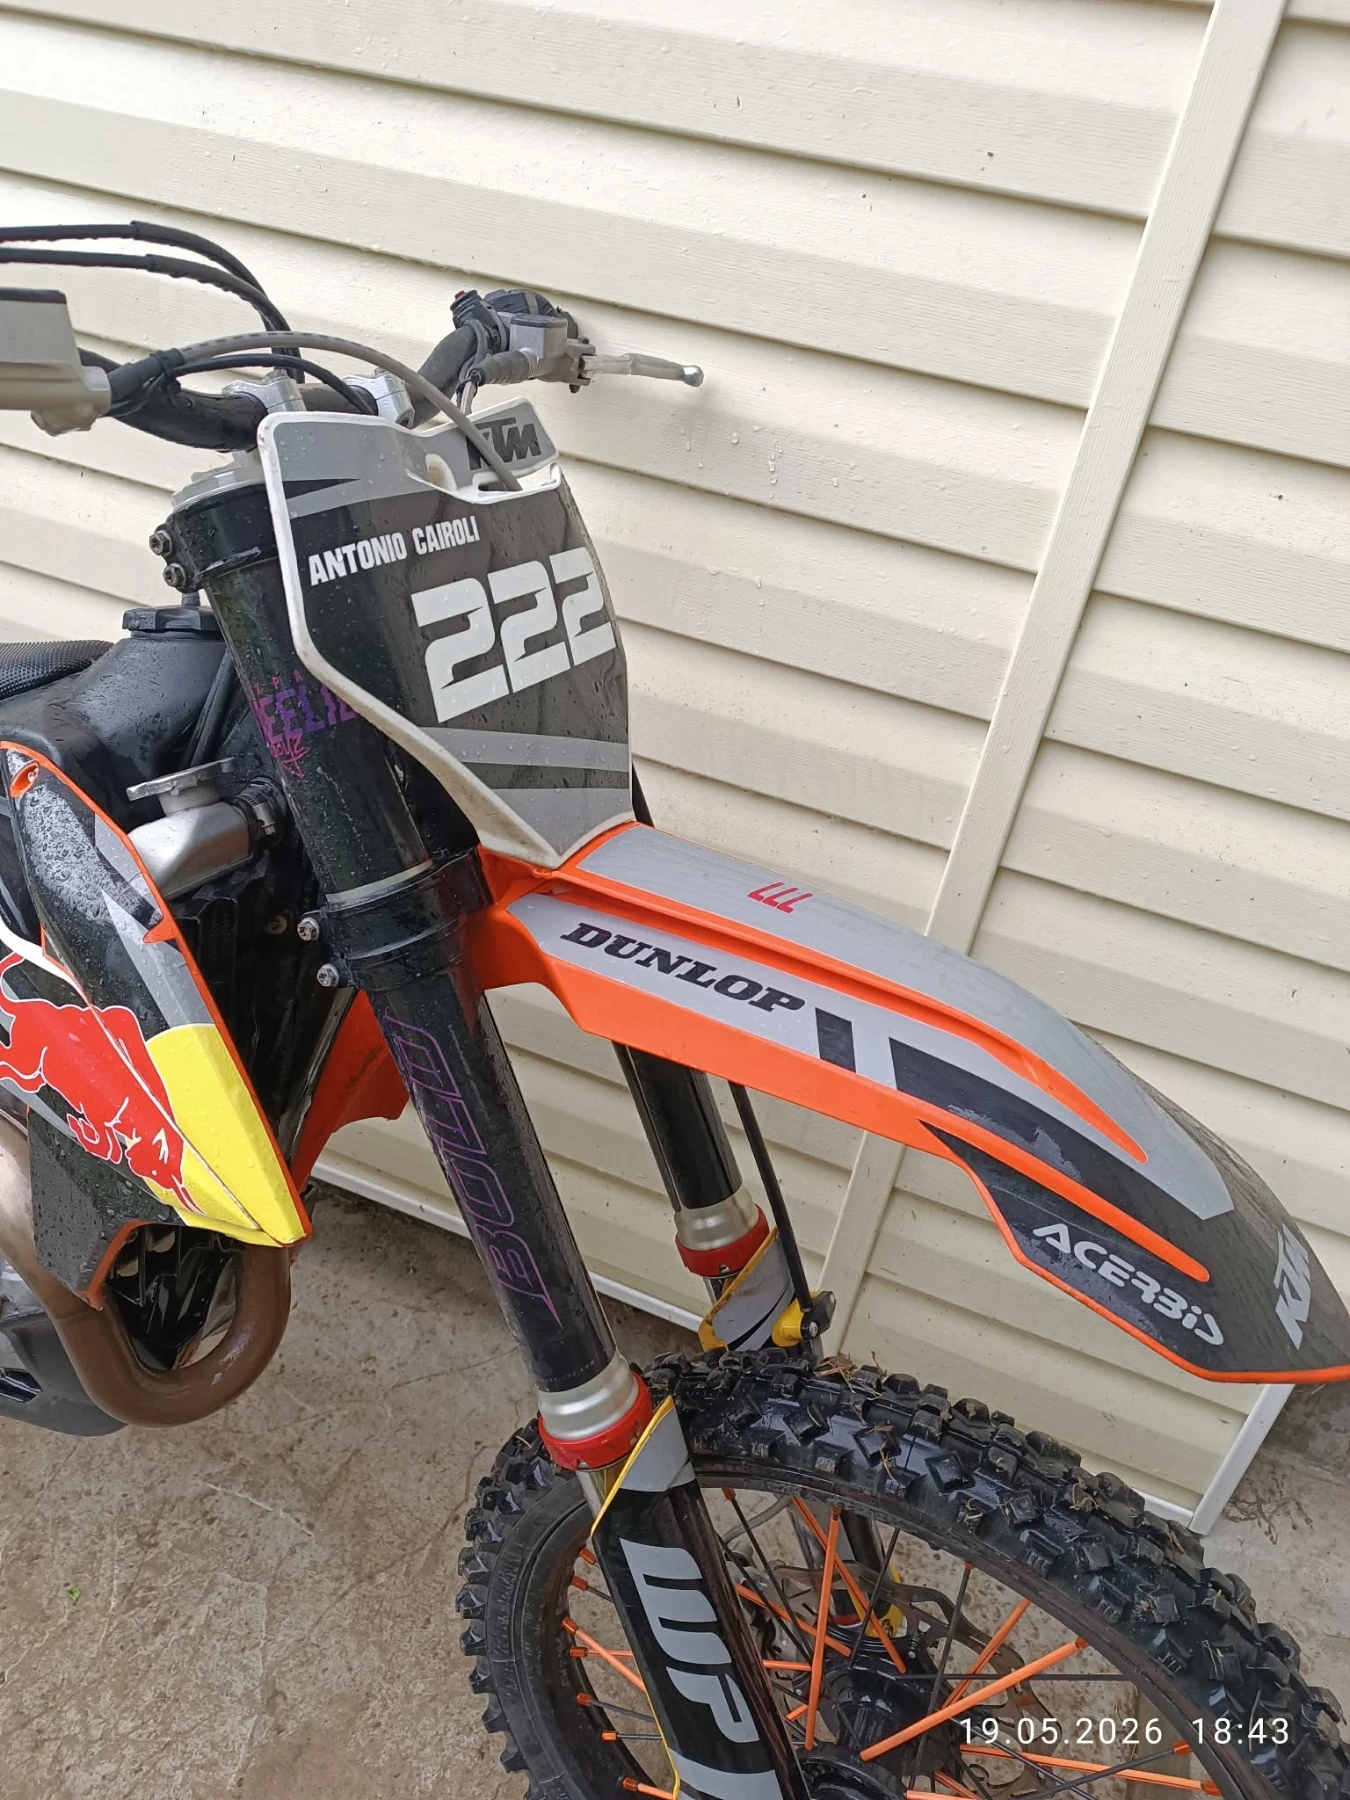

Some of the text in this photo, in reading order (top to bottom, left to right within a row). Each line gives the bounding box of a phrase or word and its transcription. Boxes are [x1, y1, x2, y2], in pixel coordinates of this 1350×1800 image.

[308, 515, 481, 586] ANTONIO CAIROLI
[411, 546, 616, 723] 222
[559, 922, 806, 1012] DUNLOP
[1273, 1222, 1312, 1351] KTM
[619, 1537, 760, 1743] WP
